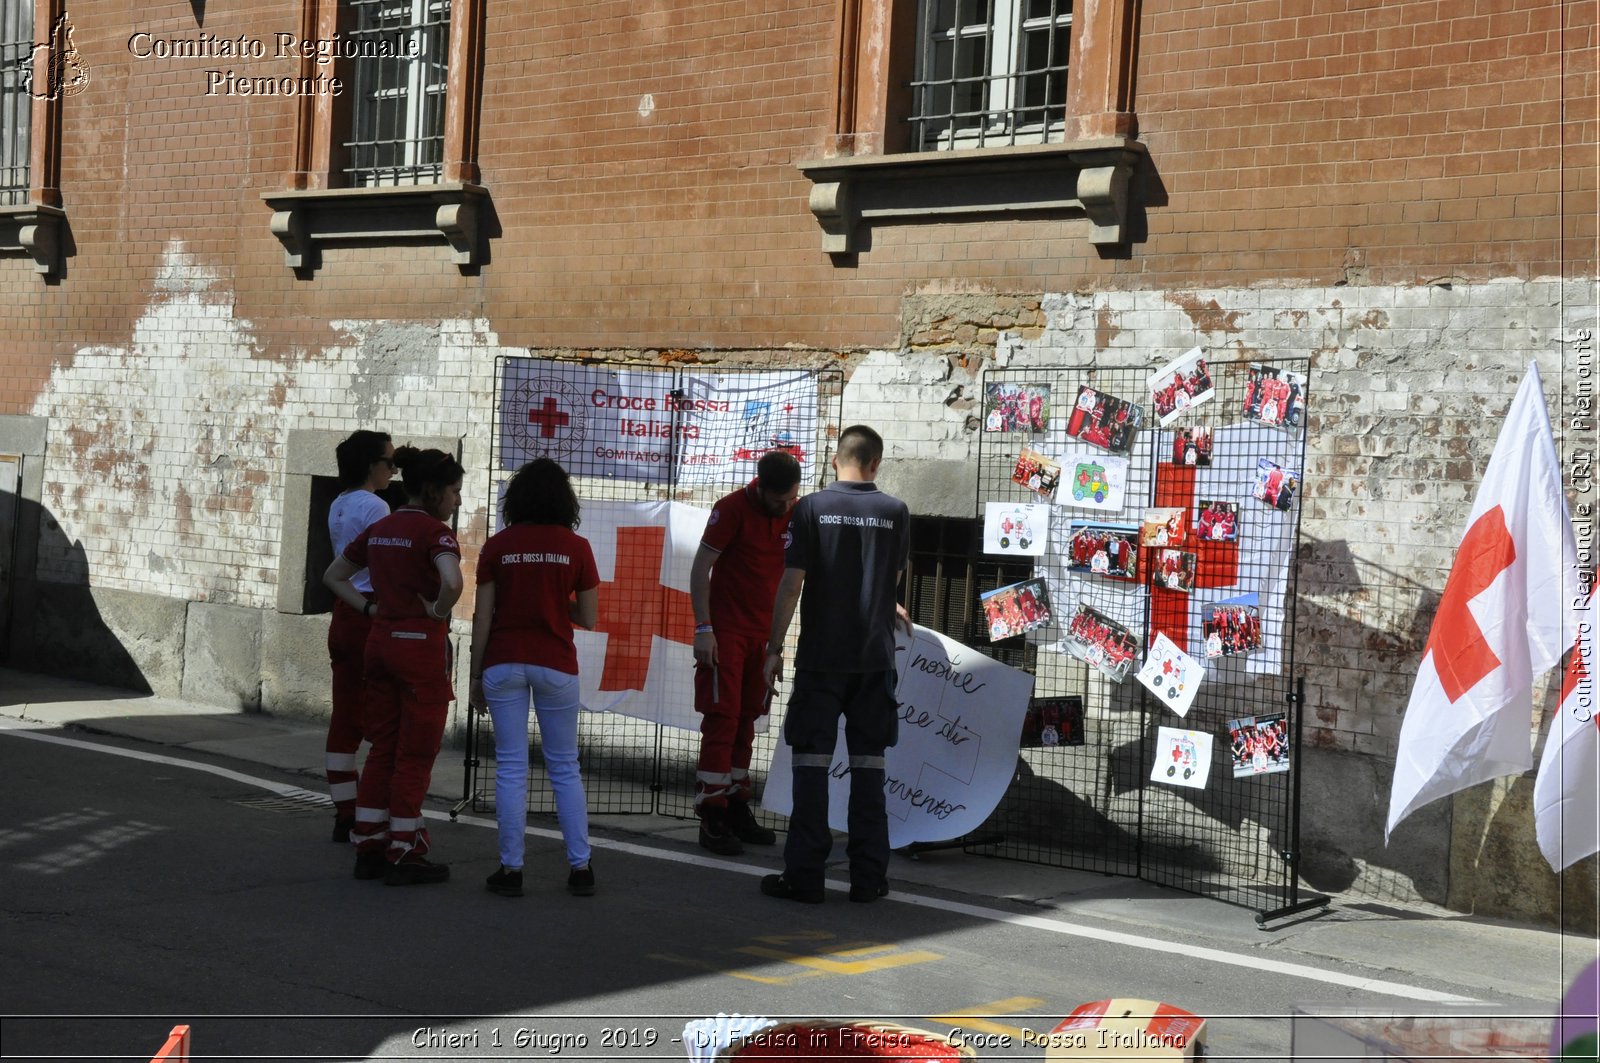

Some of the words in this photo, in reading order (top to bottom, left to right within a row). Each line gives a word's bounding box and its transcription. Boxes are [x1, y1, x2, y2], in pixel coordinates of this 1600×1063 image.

[591, 389, 656, 413] Croce
[664, 393, 730, 413] Rossa
[620, 417, 701, 440] Italiana
[595, 446, 661, 464] COMITATO
[819, 515, 842, 525] CROCE
[843, 516, 864, 526] ROSSA
[865, 517, 893, 529] ITALIANA
[501, 554, 521, 565] CROCE
[522, 553, 544, 563] ROSSA
[545, 553, 570, 565] ITALIANA
[911, 654, 986, 694] nostre
[935, 715, 970, 746] di
